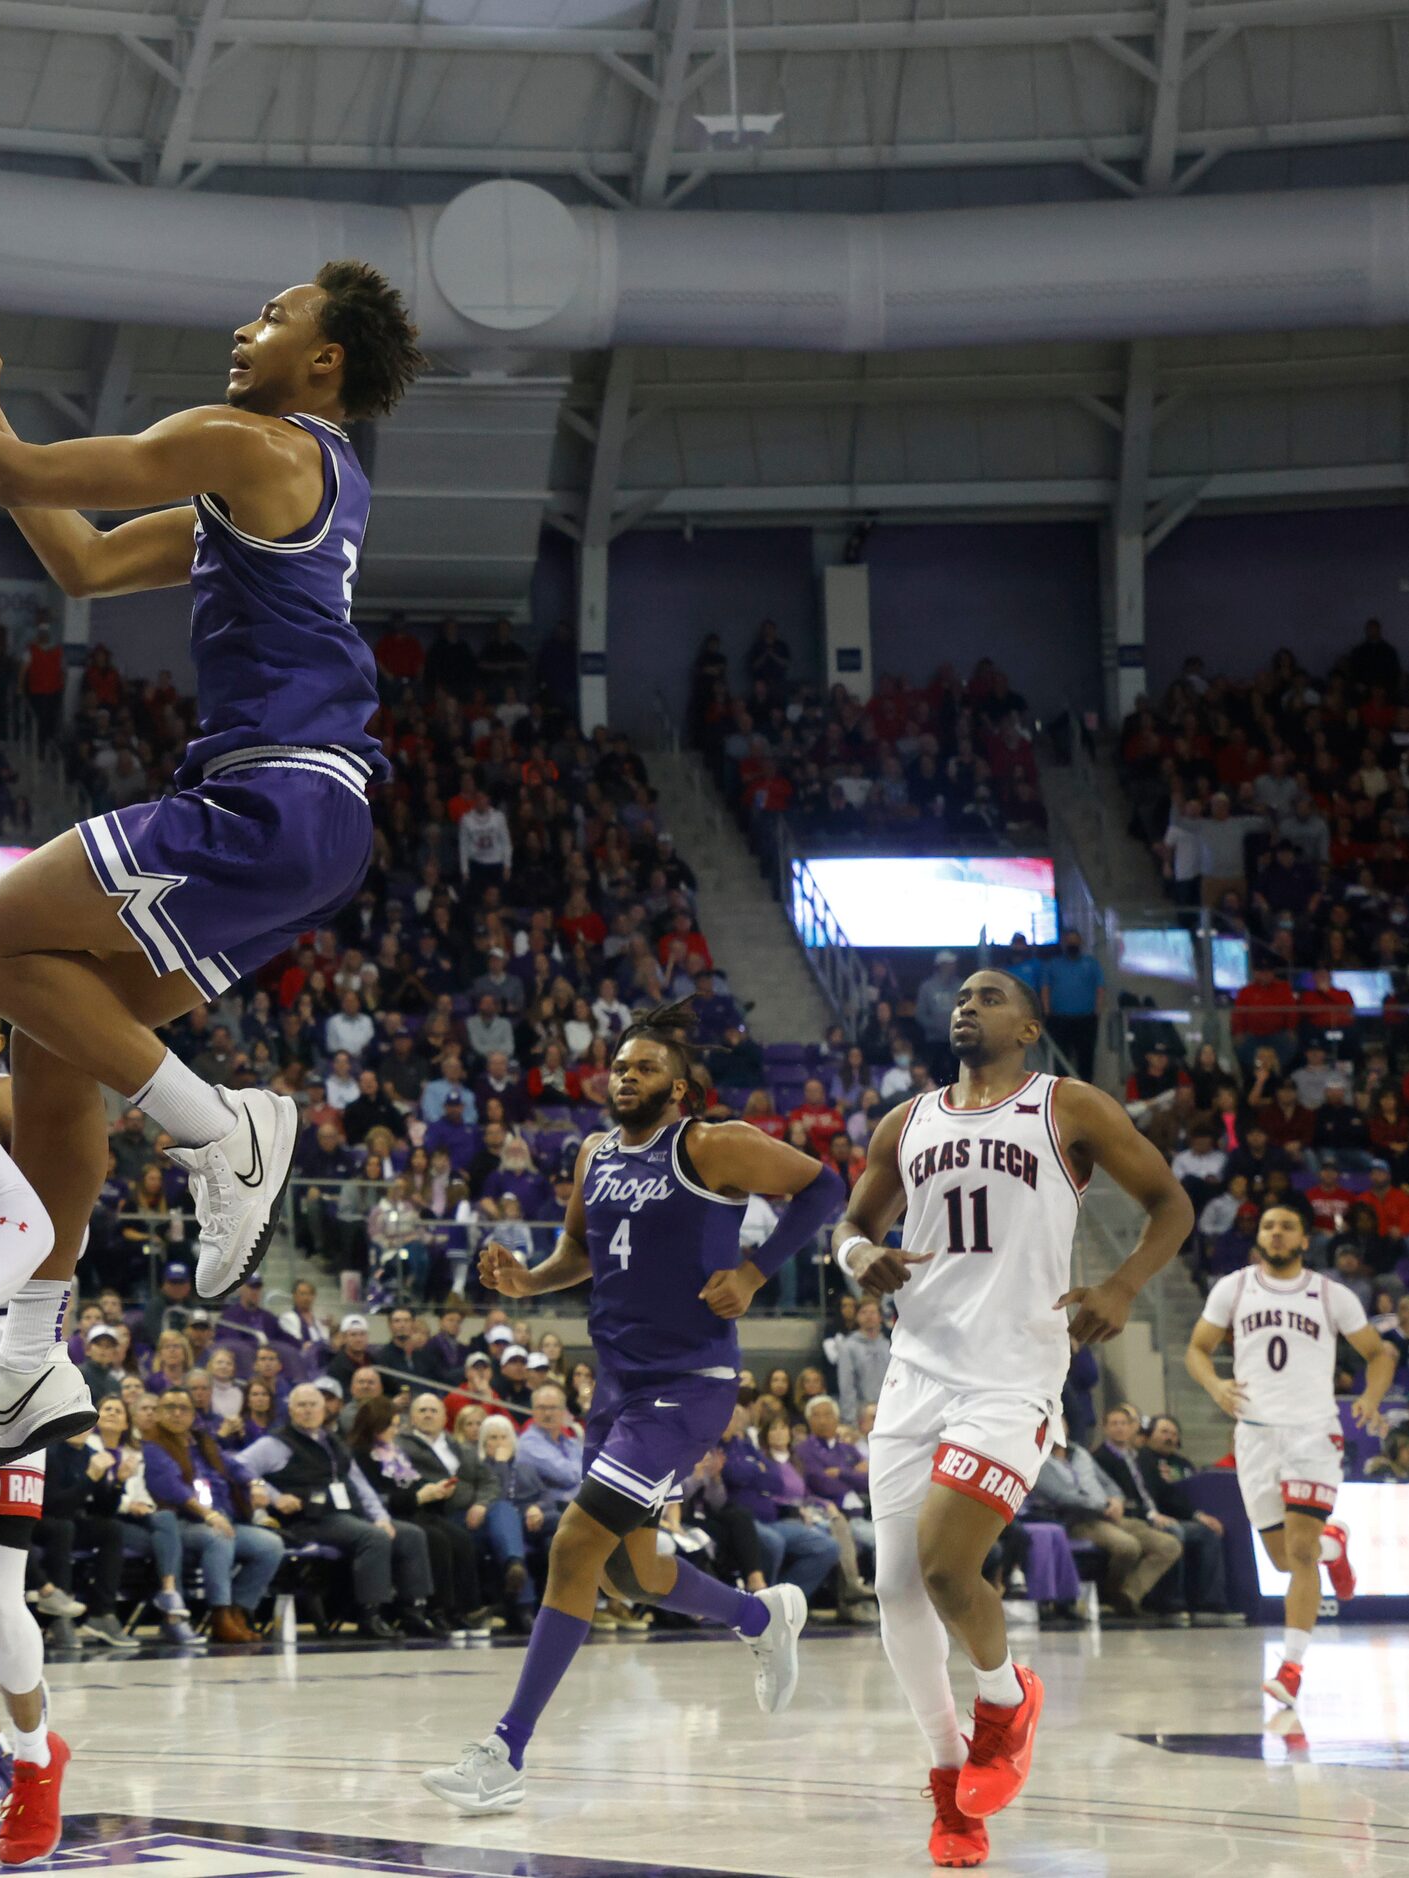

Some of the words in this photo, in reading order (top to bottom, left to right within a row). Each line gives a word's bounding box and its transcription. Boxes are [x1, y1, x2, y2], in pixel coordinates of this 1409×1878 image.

[584, 1162, 674, 1212] Frogs
[979, 1138, 1038, 1191] TECH
[609, 1219, 632, 1270] 4
[943, 1185, 993, 1254] 11
[1241, 1310, 1282, 1337] TEXAS
[1288, 1310, 1321, 1341] TECH
[1267, 1335, 1288, 1372] 0
